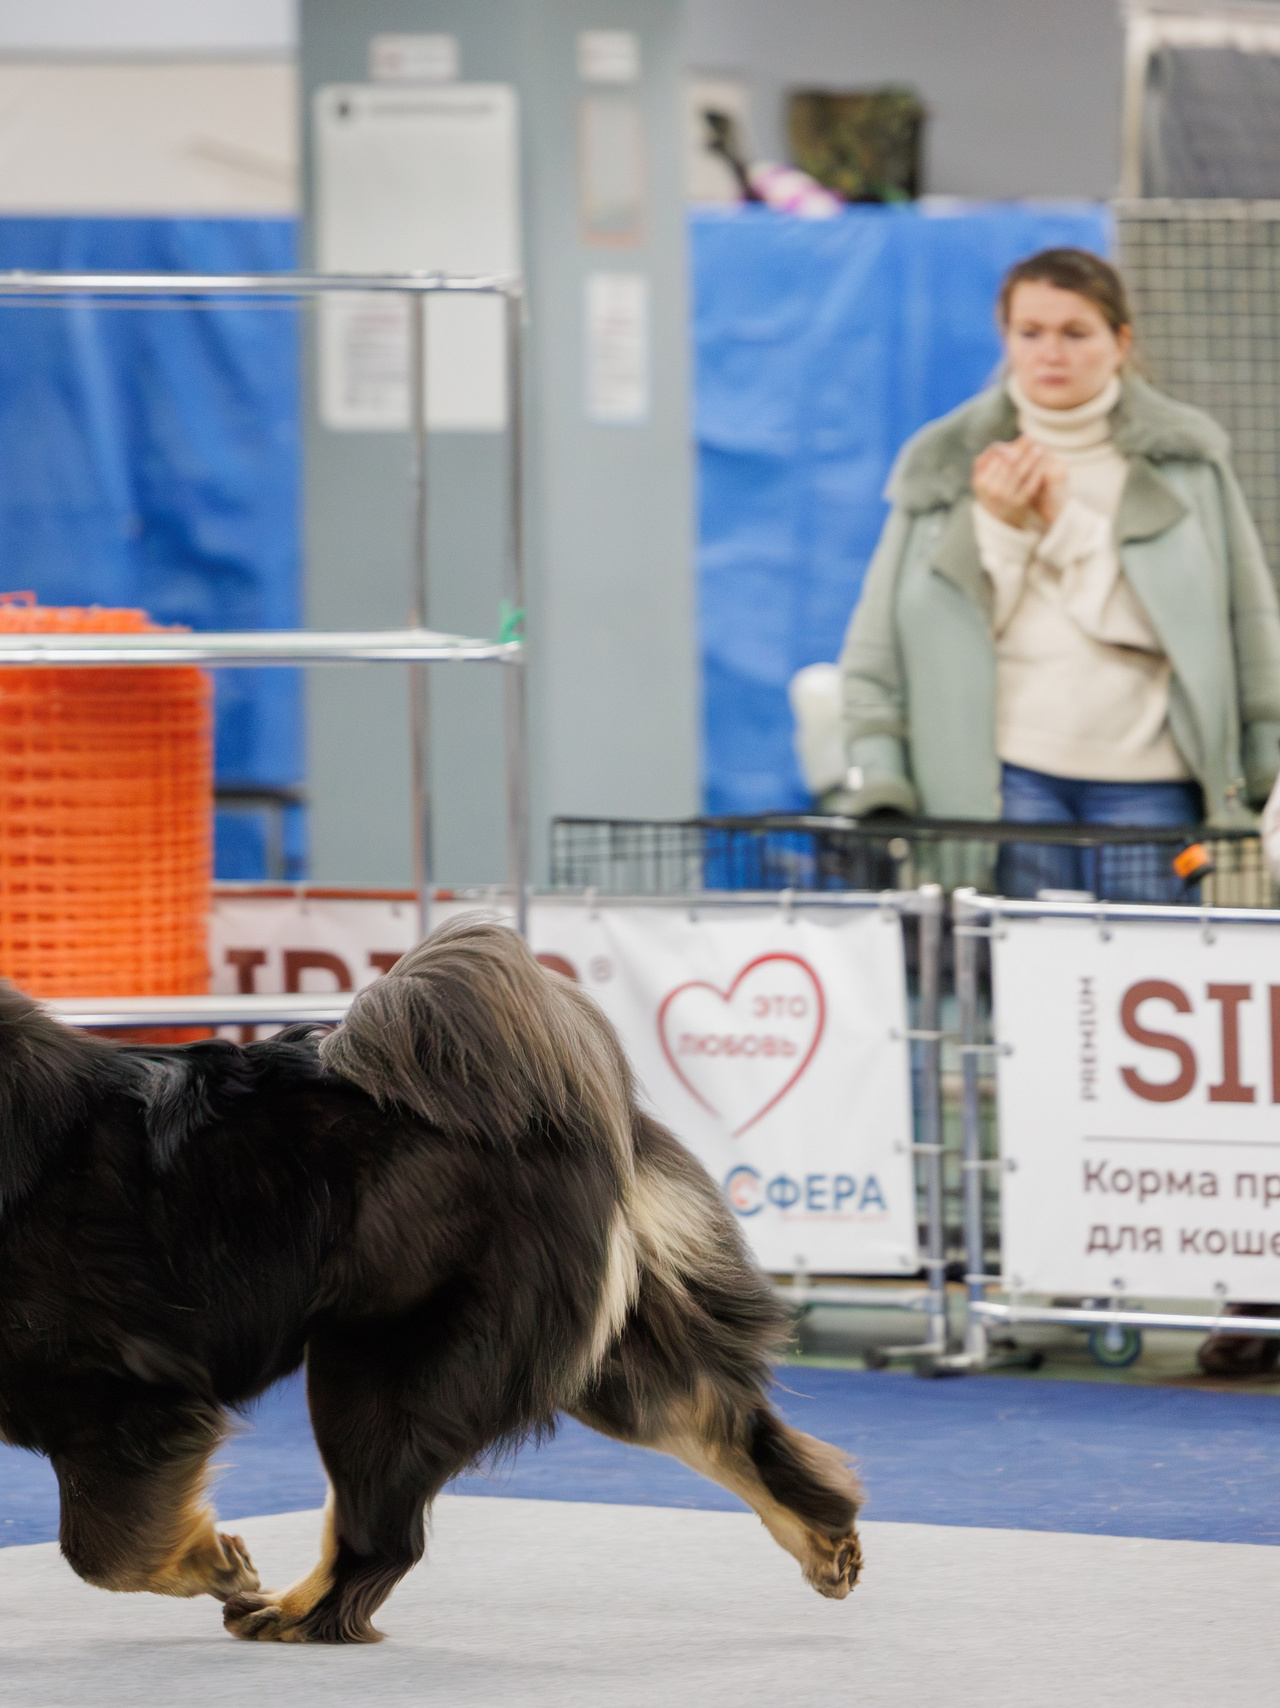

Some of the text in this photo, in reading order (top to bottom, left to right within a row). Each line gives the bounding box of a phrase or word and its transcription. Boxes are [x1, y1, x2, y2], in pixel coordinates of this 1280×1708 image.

[752, 995, 808, 1019] ЭТО
[677, 1032, 798, 1059] ЛЮБОВЬ
[1077, 975, 1097, 1101] PREMIUM
[724, 1163, 888, 1217] СФЕРА
[1083, 1160, 1220, 1203] Корма
[1086, 1224, 1163, 1254] для
